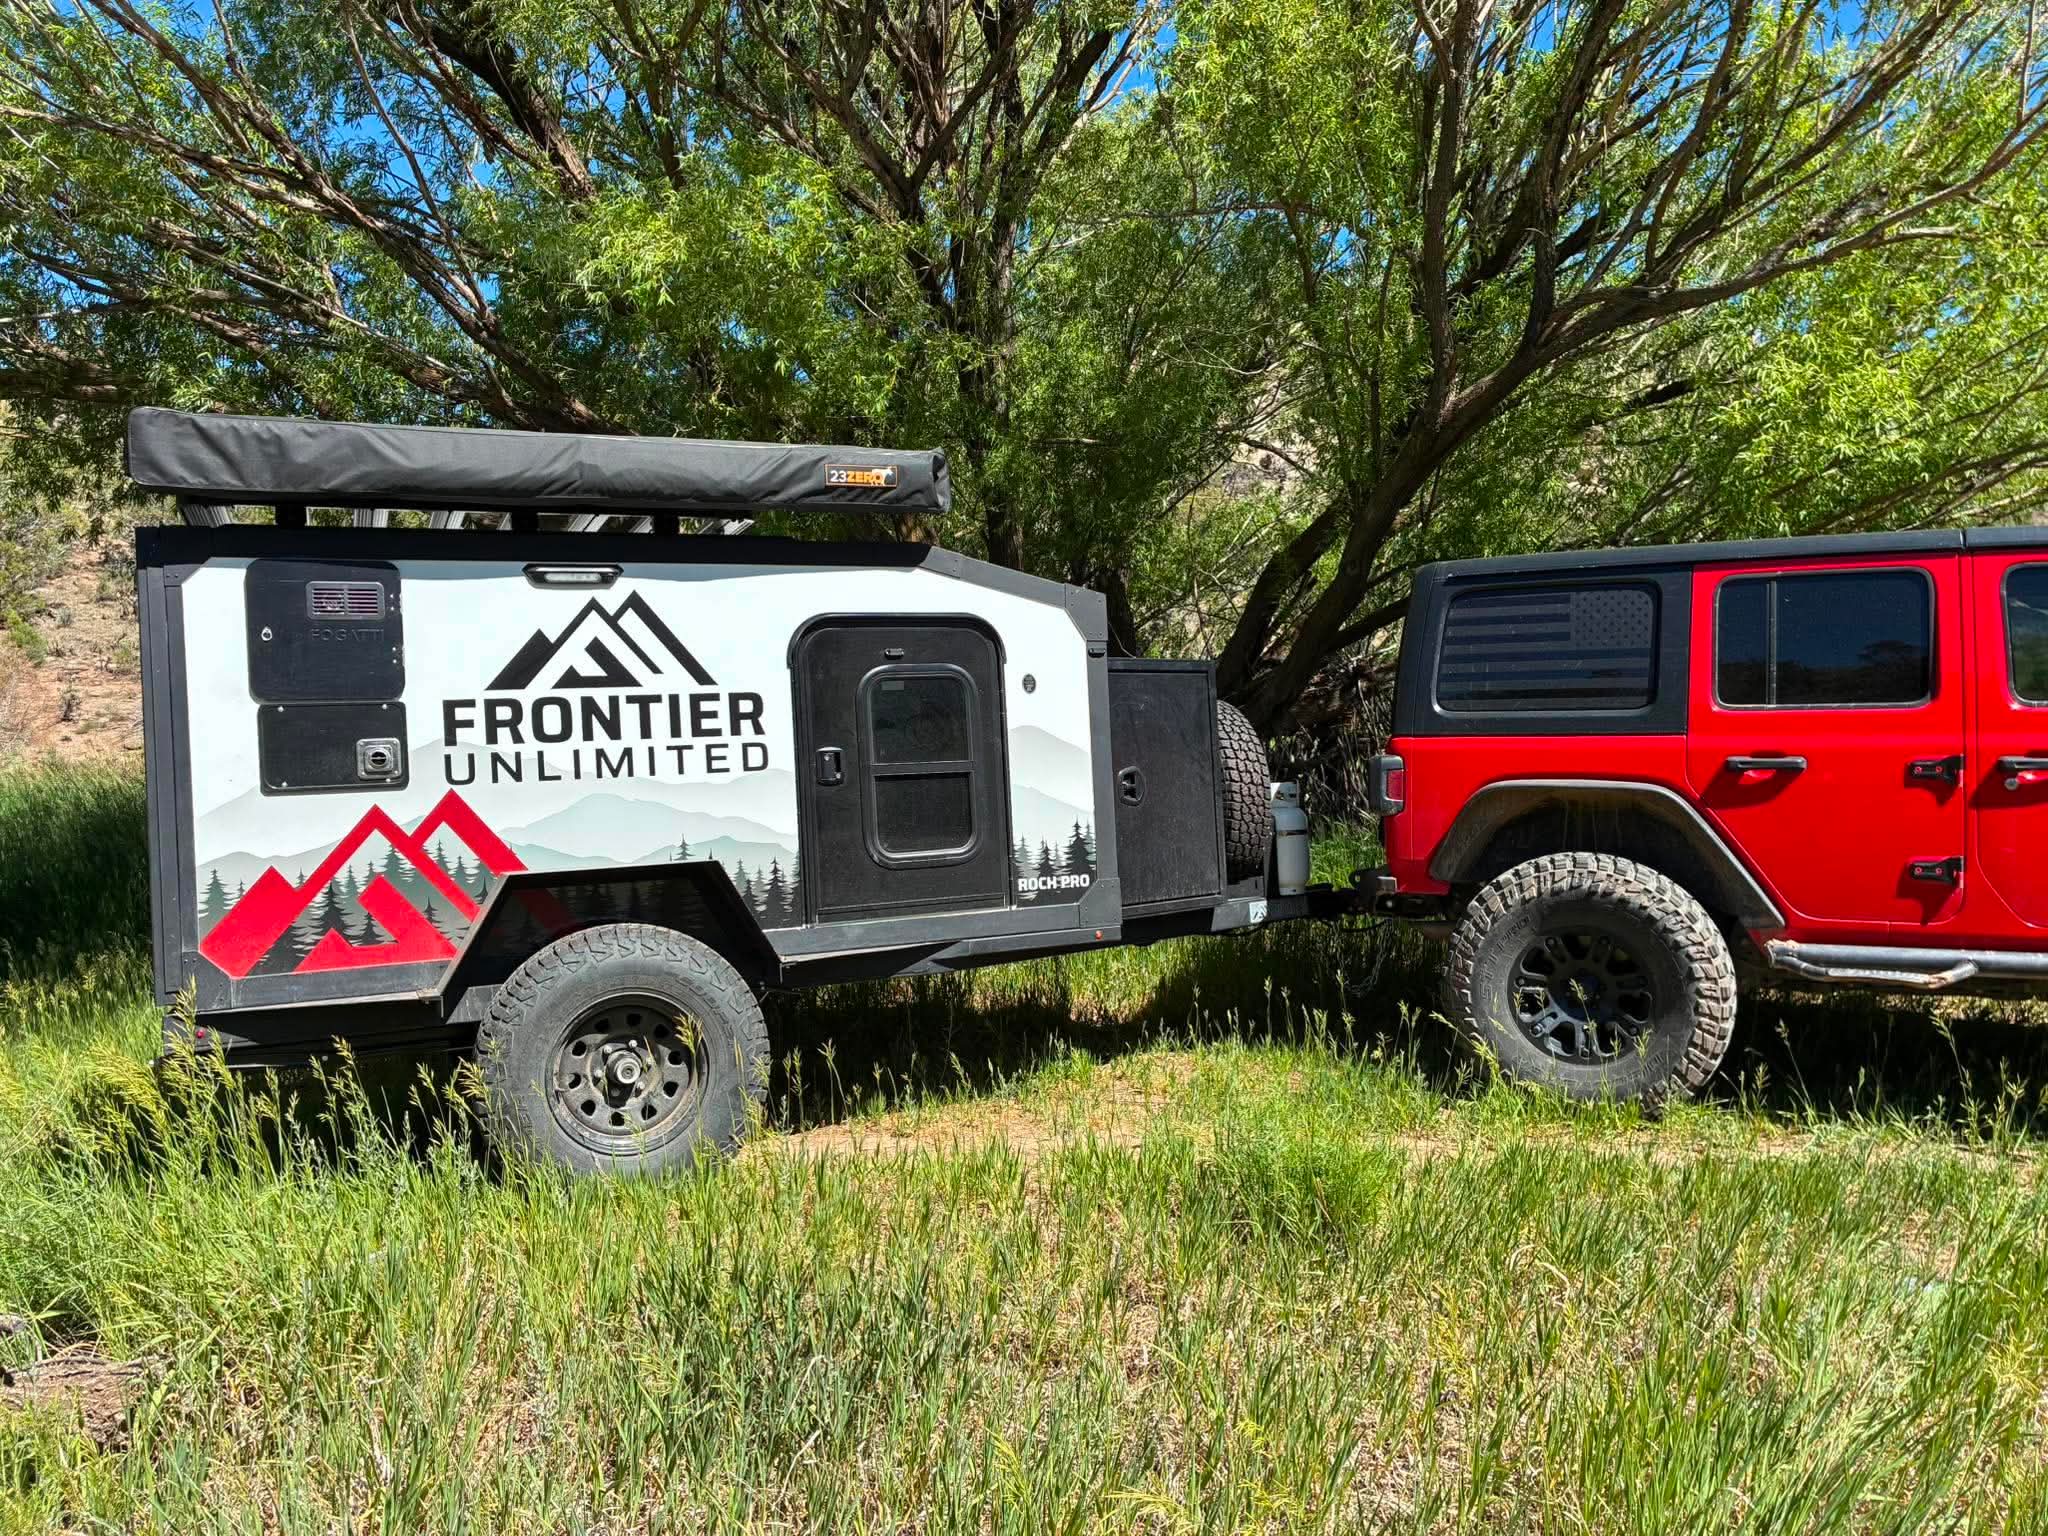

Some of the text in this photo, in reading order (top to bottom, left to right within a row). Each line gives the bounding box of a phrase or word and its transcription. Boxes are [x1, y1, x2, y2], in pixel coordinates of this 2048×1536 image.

[830, 469, 884, 484] 23ZERO
[311, 628, 385, 641] FOGATTI
[442, 692, 766, 747] FRONTIER
[444, 742, 769, 786] UNLIMITED
[1018, 874, 1090, 891] ROCH PRO
